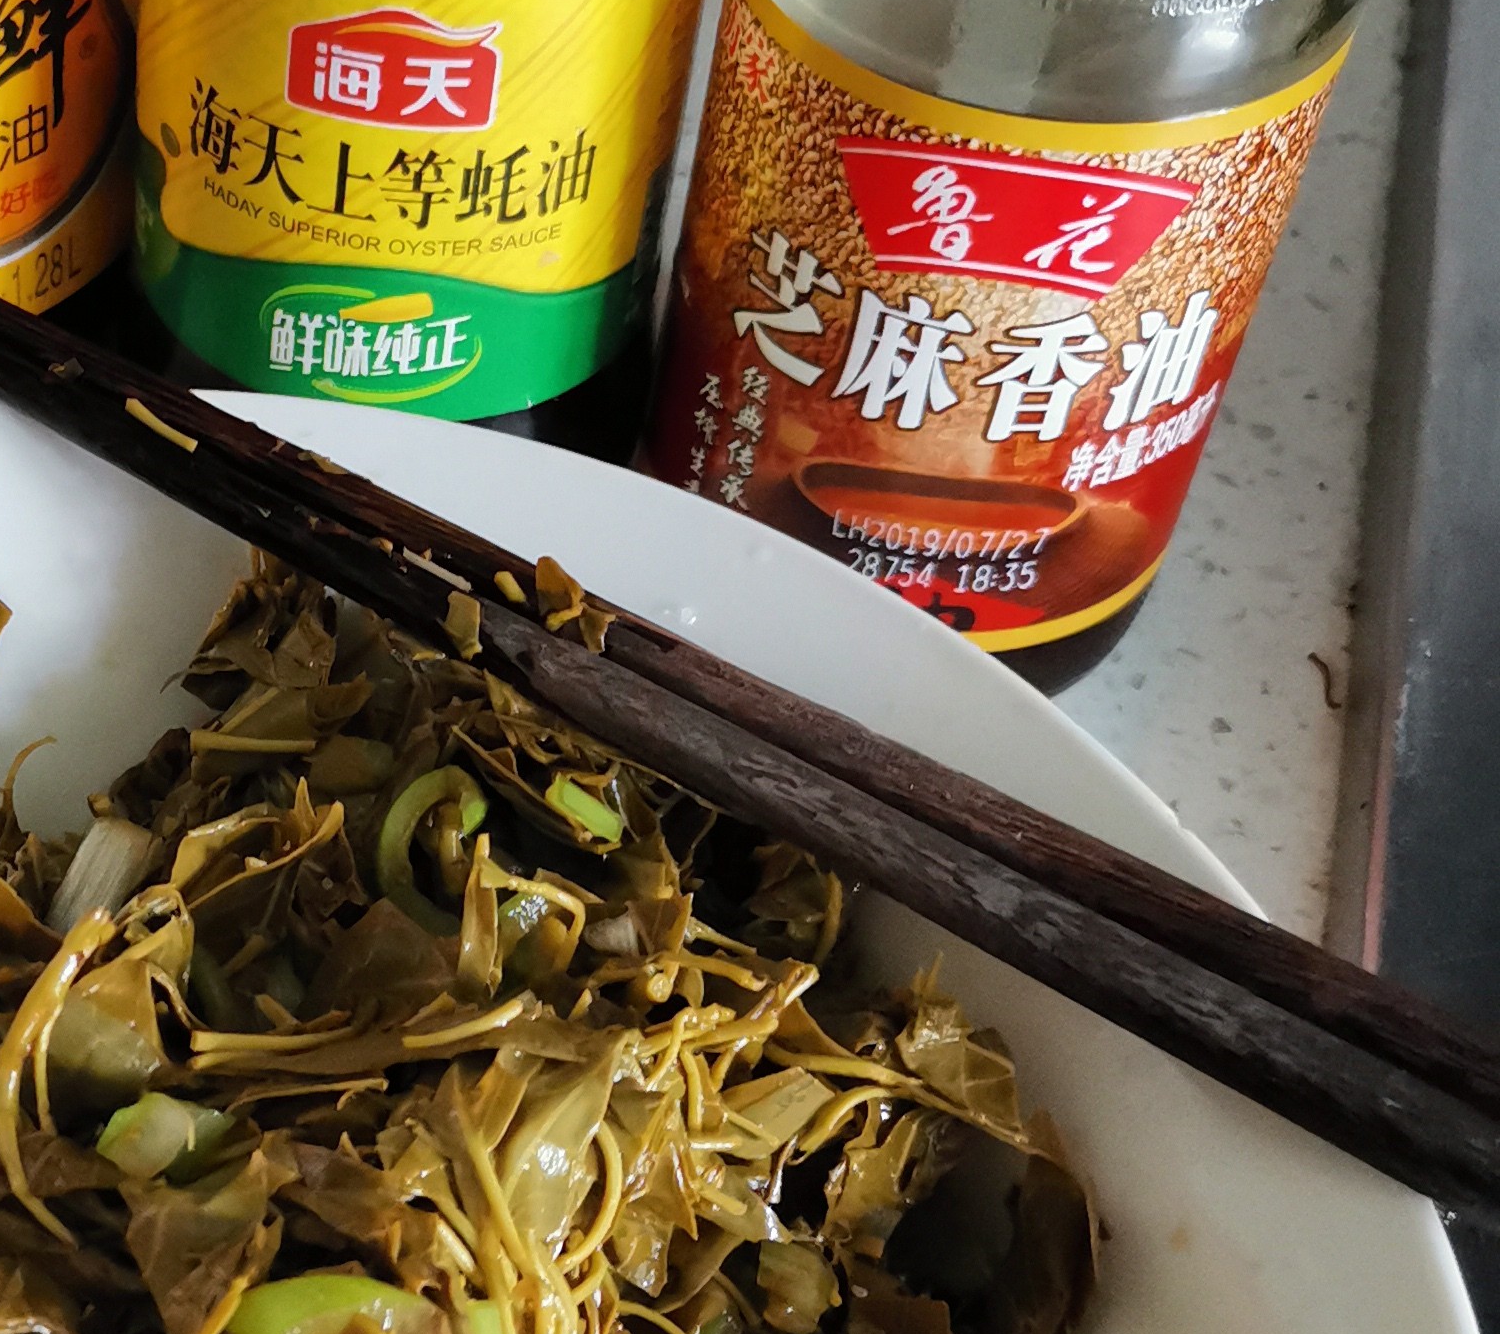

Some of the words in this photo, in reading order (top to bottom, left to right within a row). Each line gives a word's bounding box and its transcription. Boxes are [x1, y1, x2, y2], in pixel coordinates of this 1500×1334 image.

[314, 42, 474, 118] 海天
[188, 76, 597, 230] 海天上等蚝油
[203, 176, 263, 219] HADAY
[267, 211, 380, 253] SUPERIOR
[388, 239, 482, 257] OYSTER
[489, 223, 563, 254] SAUCE
[887, 165, 1131, 273] 鲁花
[269, 308, 473, 377] 鲜味纯正
[733, 230, 1219, 444] 芝麻香油
[831, 508, 1052, 561] LH2019/07/27
[953, 560, 1040, 594] 18:35
